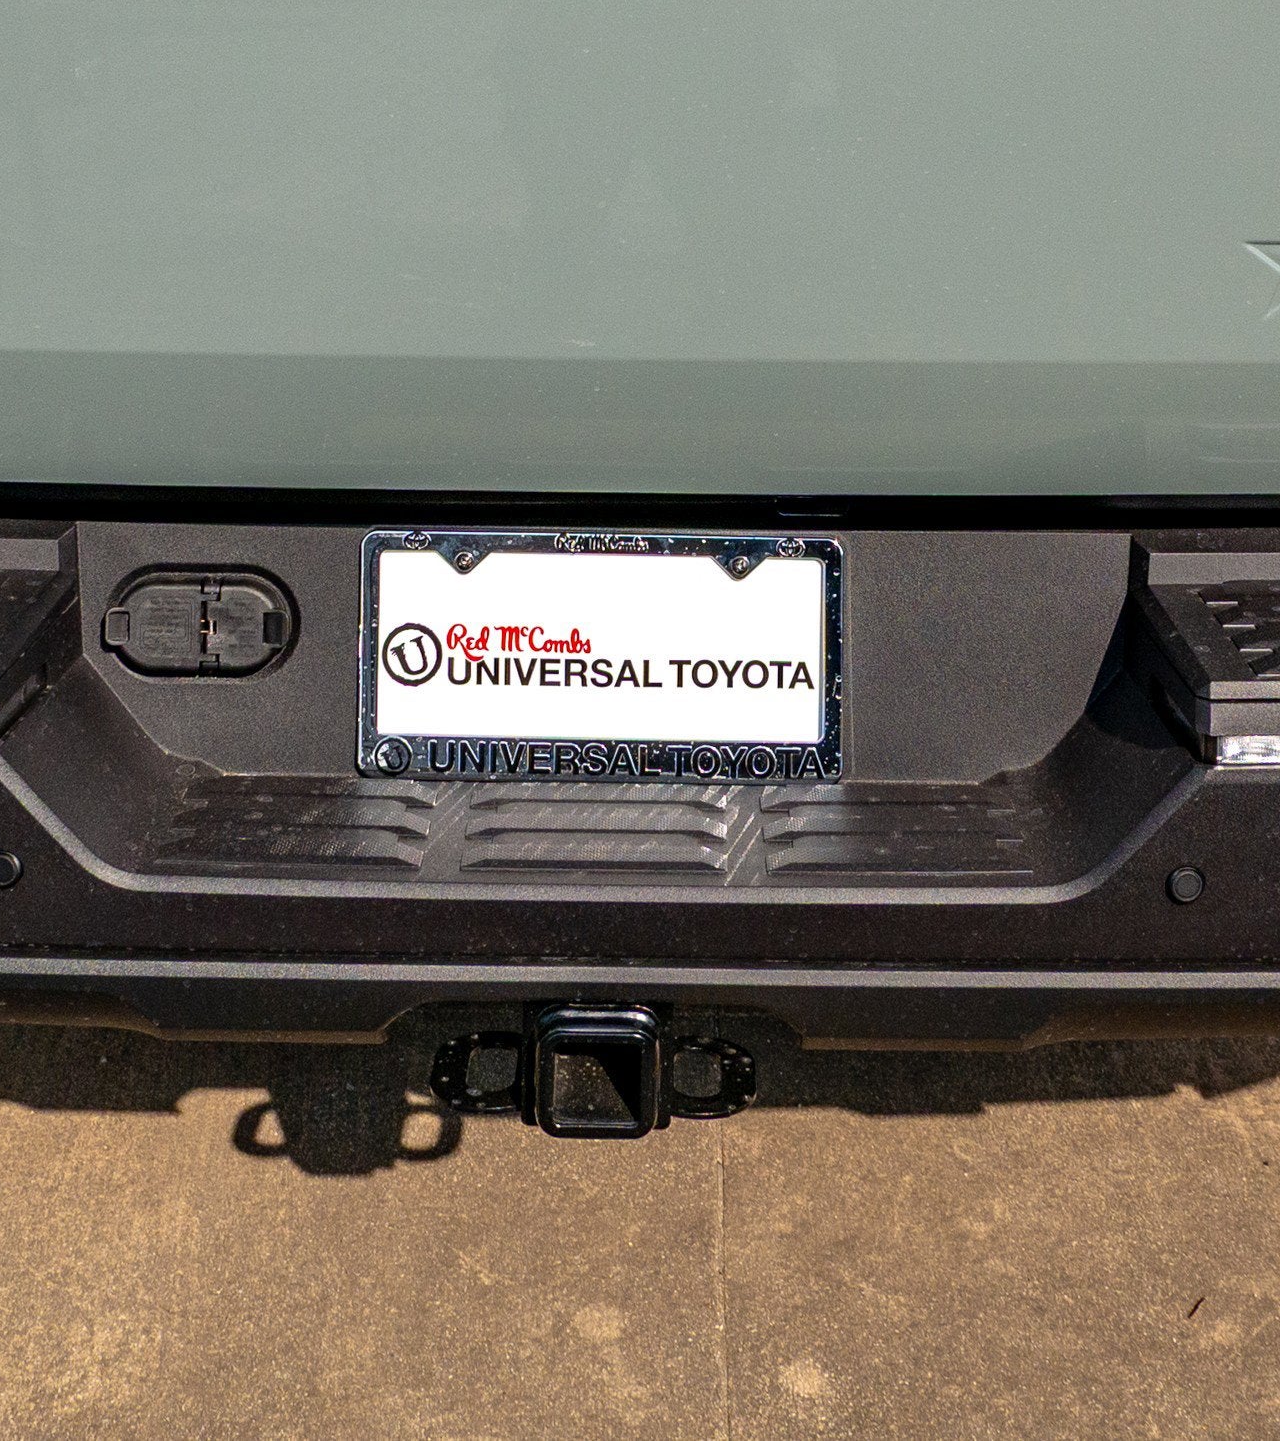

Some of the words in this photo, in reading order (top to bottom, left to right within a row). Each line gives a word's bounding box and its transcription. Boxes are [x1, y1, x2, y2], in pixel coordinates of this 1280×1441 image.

[446, 623, 490, 661] Red
[494, 626, 591, 653] McCombs
[447, 657, 662, 688] UNIVERSAL
[669, 659, 815, 689] TOYOTA
[427, 739, 662, 776] UNIVERSAL
[666, 744, 826, 779] TOYOTA
